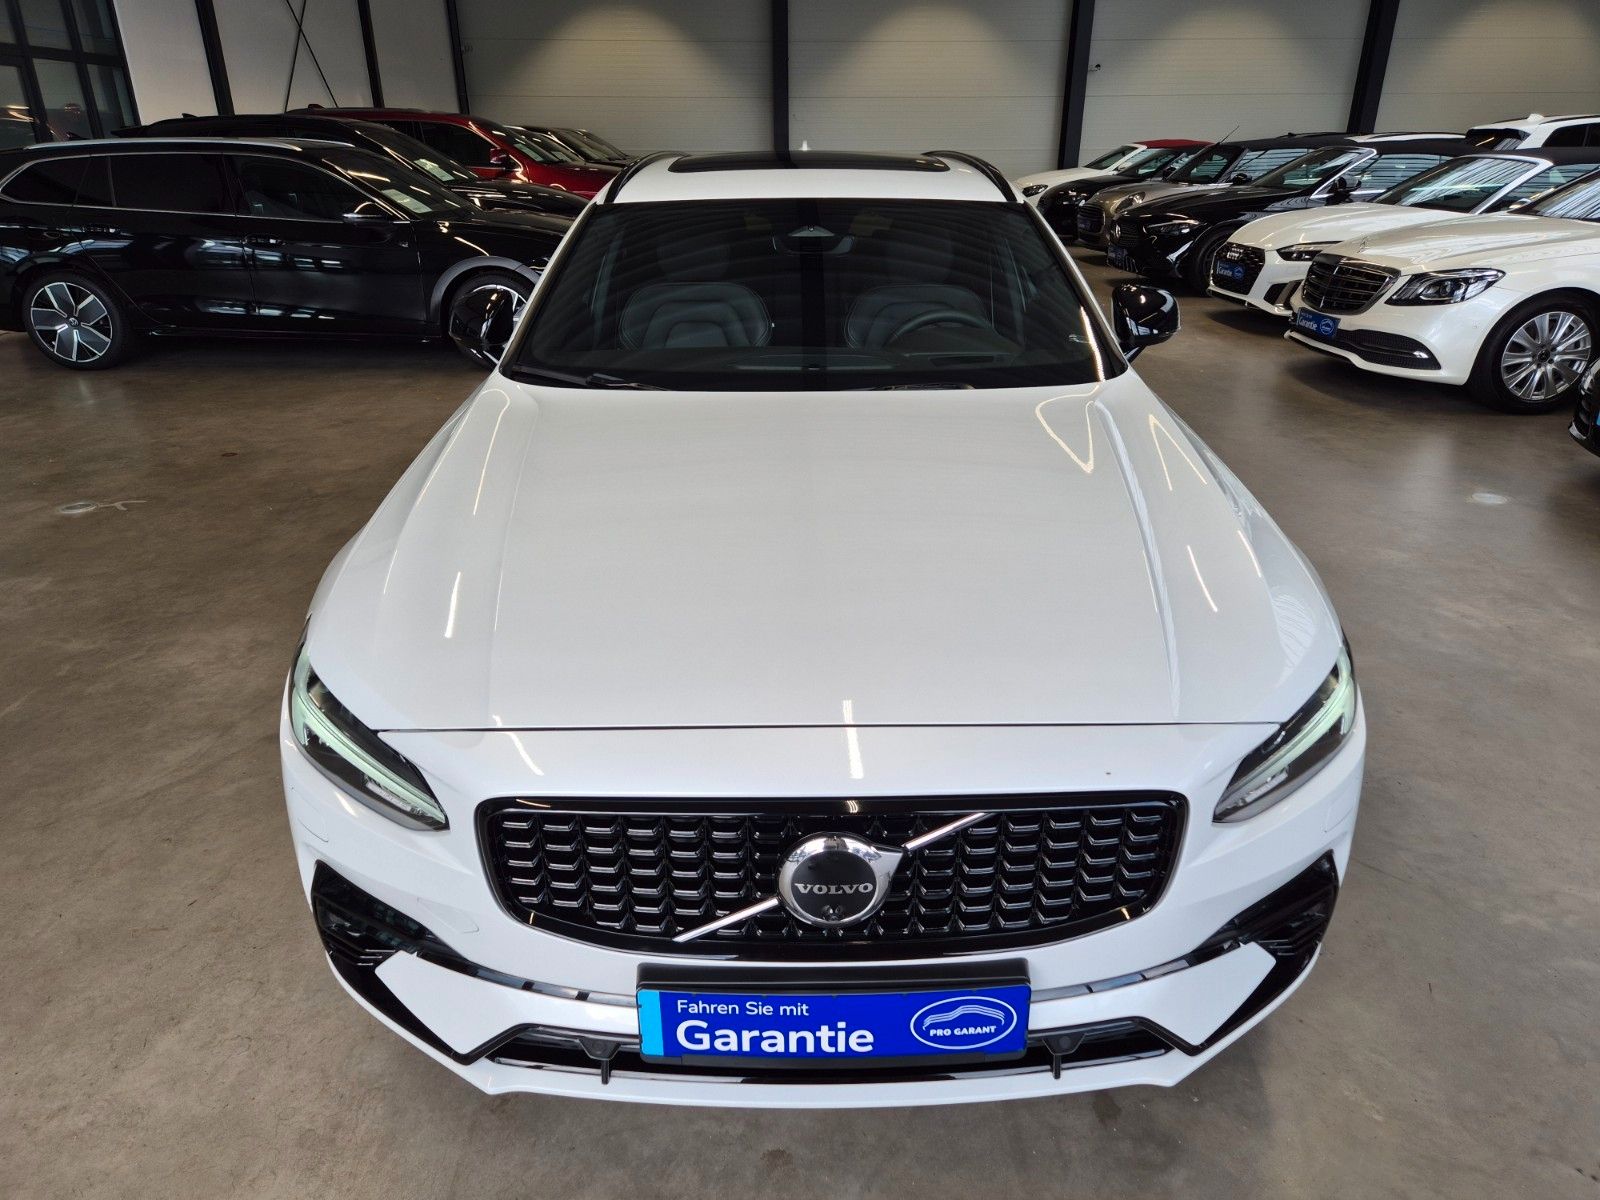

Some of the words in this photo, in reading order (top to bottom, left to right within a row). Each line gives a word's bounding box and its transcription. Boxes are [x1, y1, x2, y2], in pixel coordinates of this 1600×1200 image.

[794, 883, 874, 895] VOLVO
[677, 1000, 739, 1014] Fahren
[746, 1001, 773, 1015] Sie
[780, 1003, 809, 1016] mit
[676, 1019, 874, 1053] Garantie
[929, 1029, 951, 1037] PRO
[954, 1026, 997, 1036] GARANT
